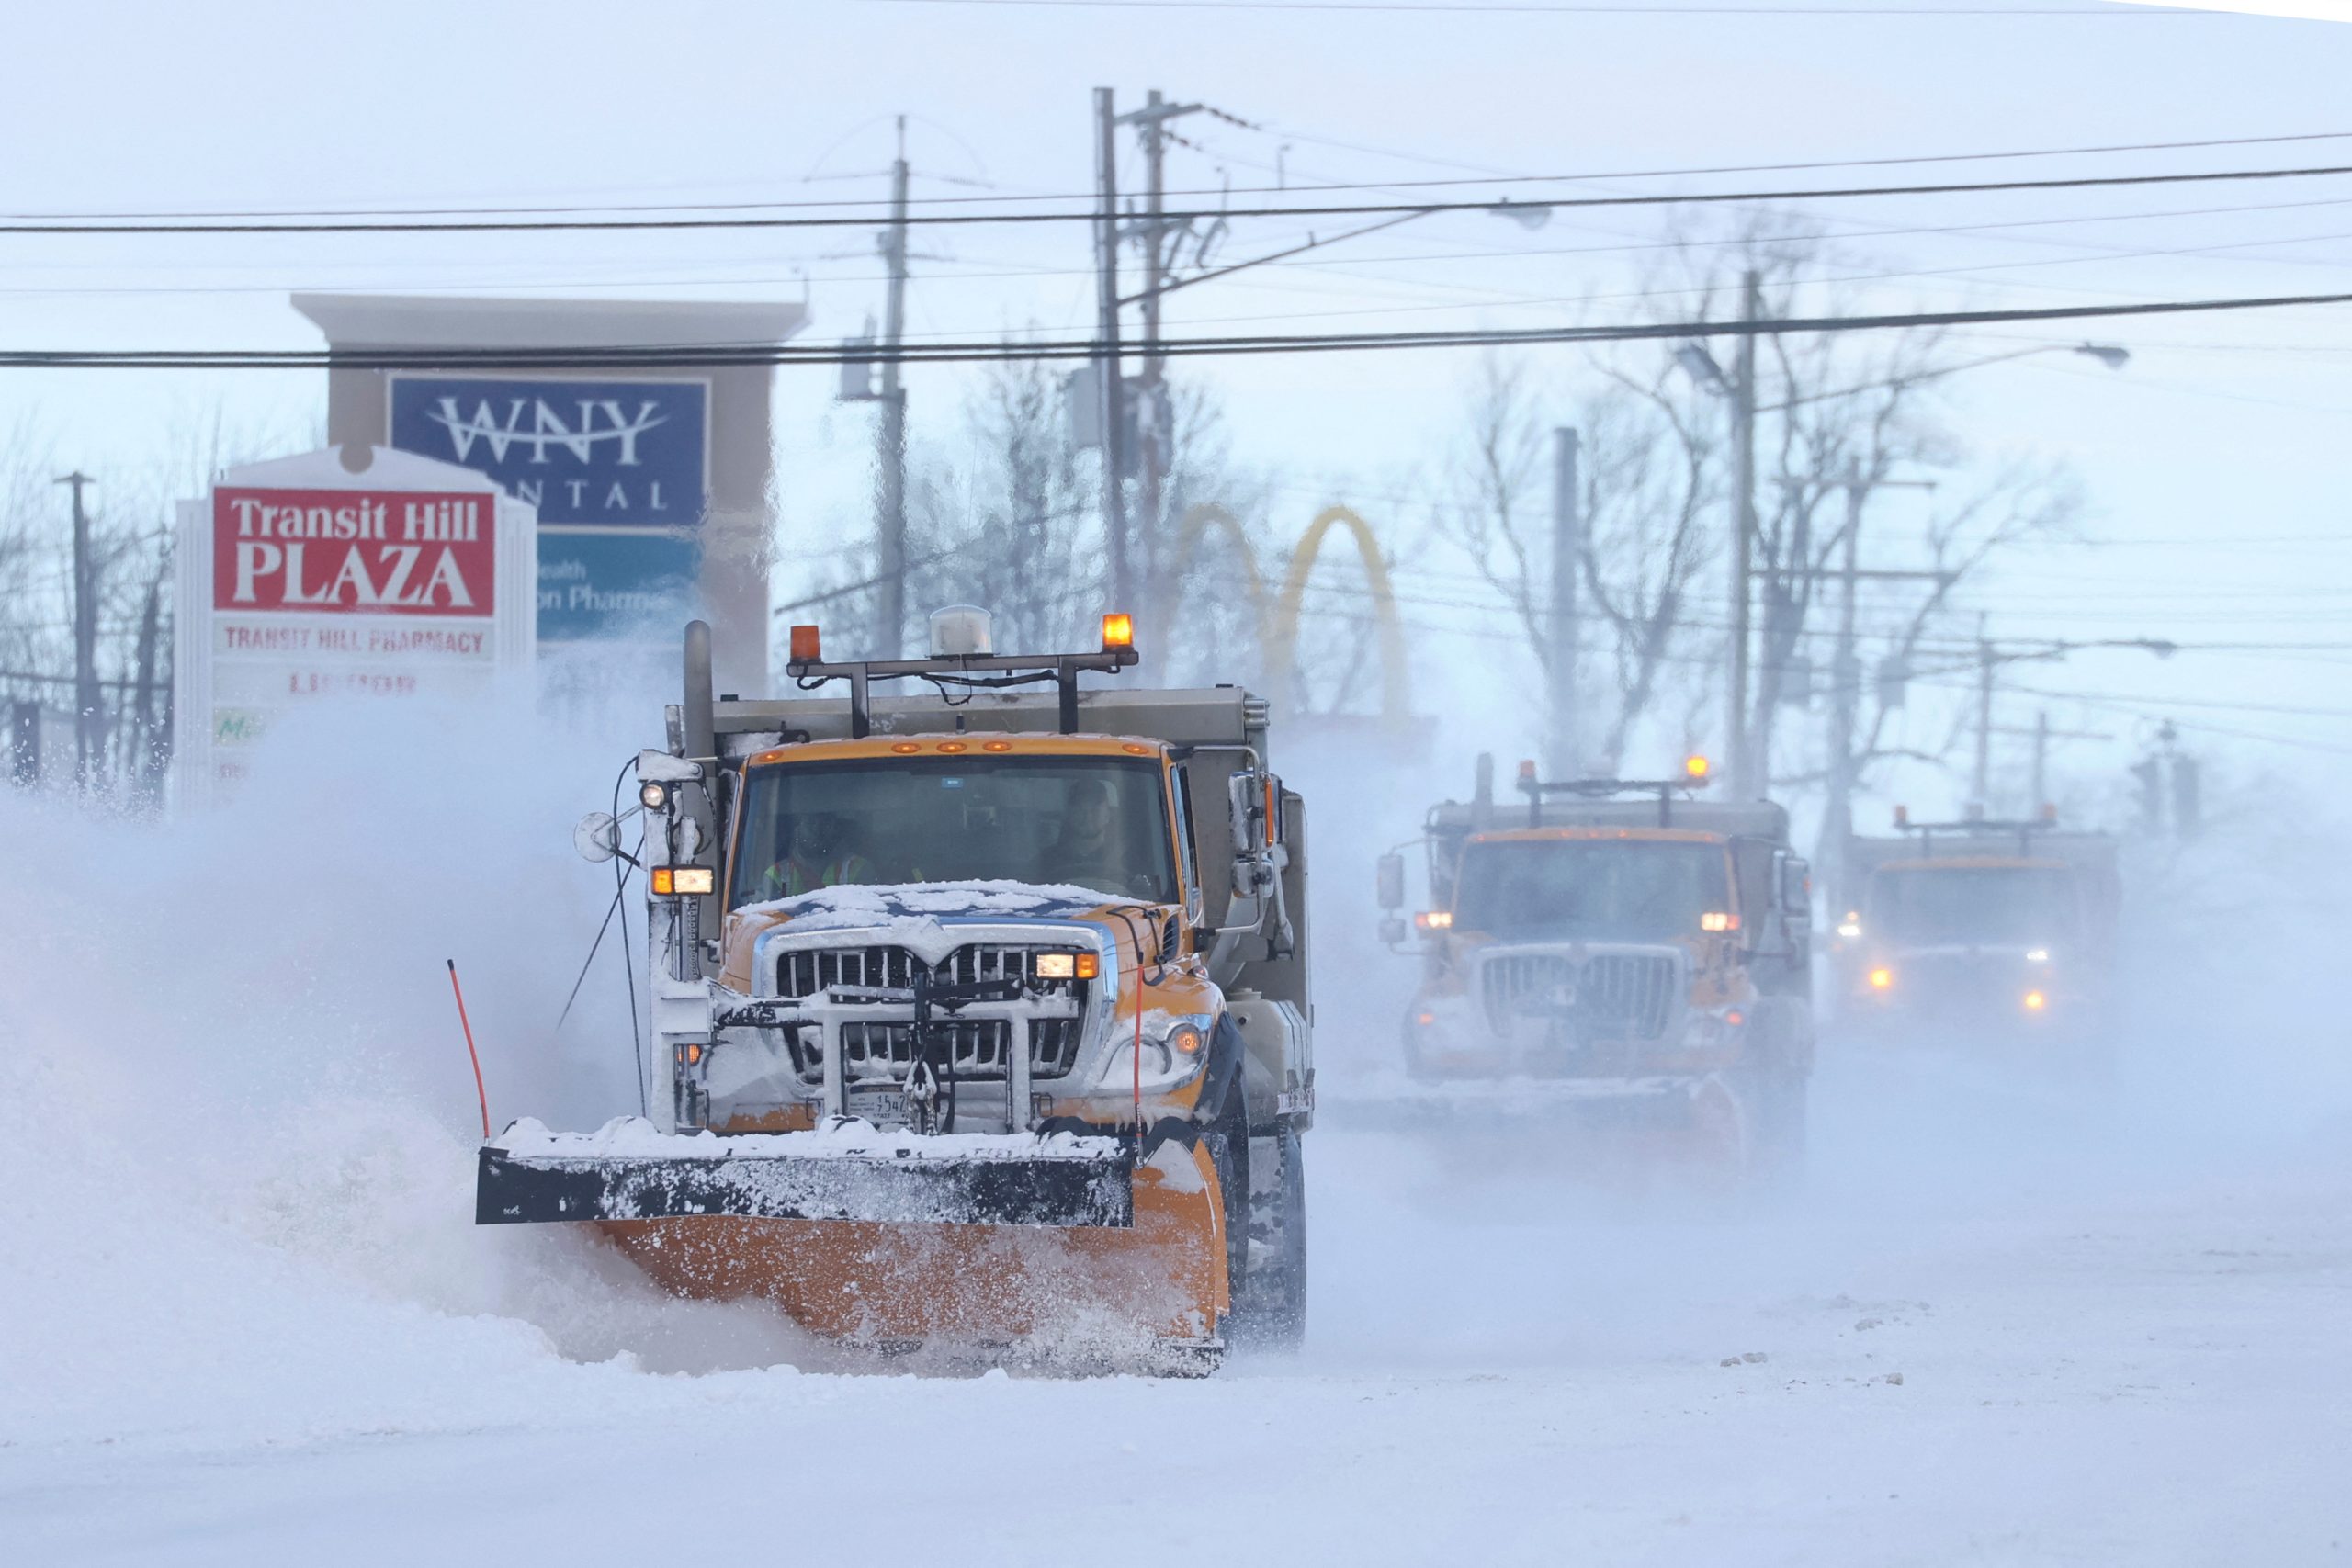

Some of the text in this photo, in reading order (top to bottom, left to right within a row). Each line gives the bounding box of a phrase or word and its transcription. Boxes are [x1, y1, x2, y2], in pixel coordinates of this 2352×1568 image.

[432, 396, 663, 466] WNY
[516, 478, 669, 511] NTAL
[231, 496, 478, 542] Transit Hill
[232, 541, 476, 608] PLAZA
[225, 626, 485, 655] TRANSIT HILL PHARMACY
